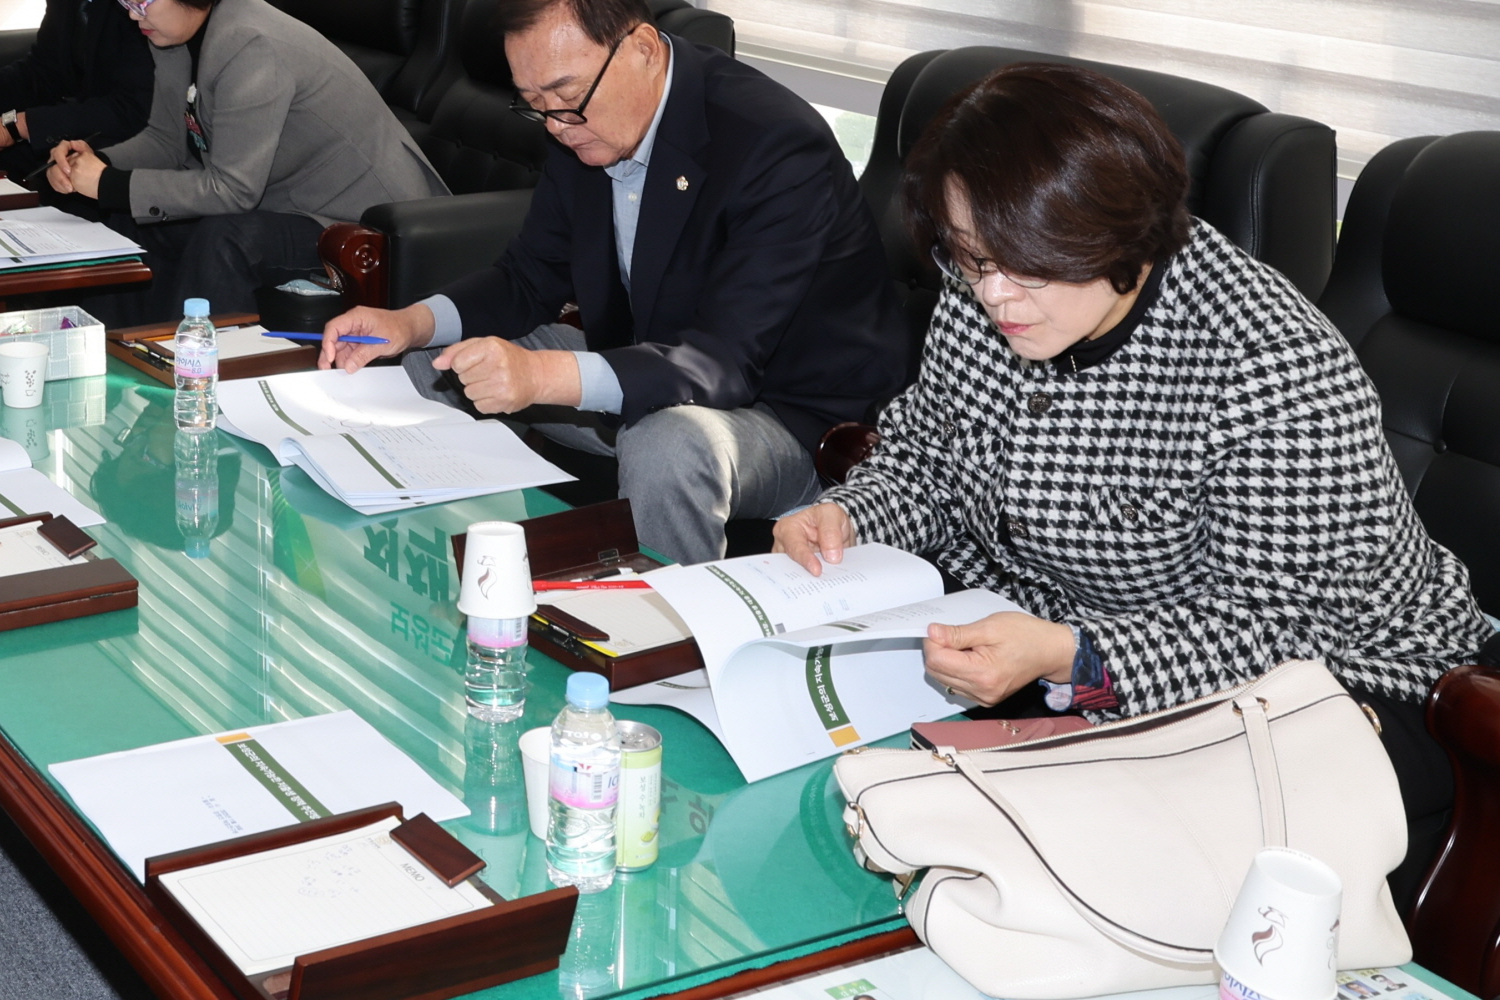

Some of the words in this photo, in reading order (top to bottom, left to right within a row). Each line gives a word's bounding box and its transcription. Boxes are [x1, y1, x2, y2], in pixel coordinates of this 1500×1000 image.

[814, 645, 824, 683] 지속가능
[818, 685, 838, 722] 보성군의
[237, 743, 258, 762] 보성군의
[255, 760, 282, 782] 지속가능한
[277, 782, 296, 796] 저출생
[290, 796, 307, 806] 정책
[608, 776, 619, 788] IC
[400, 862, 425, 882] MEMO
